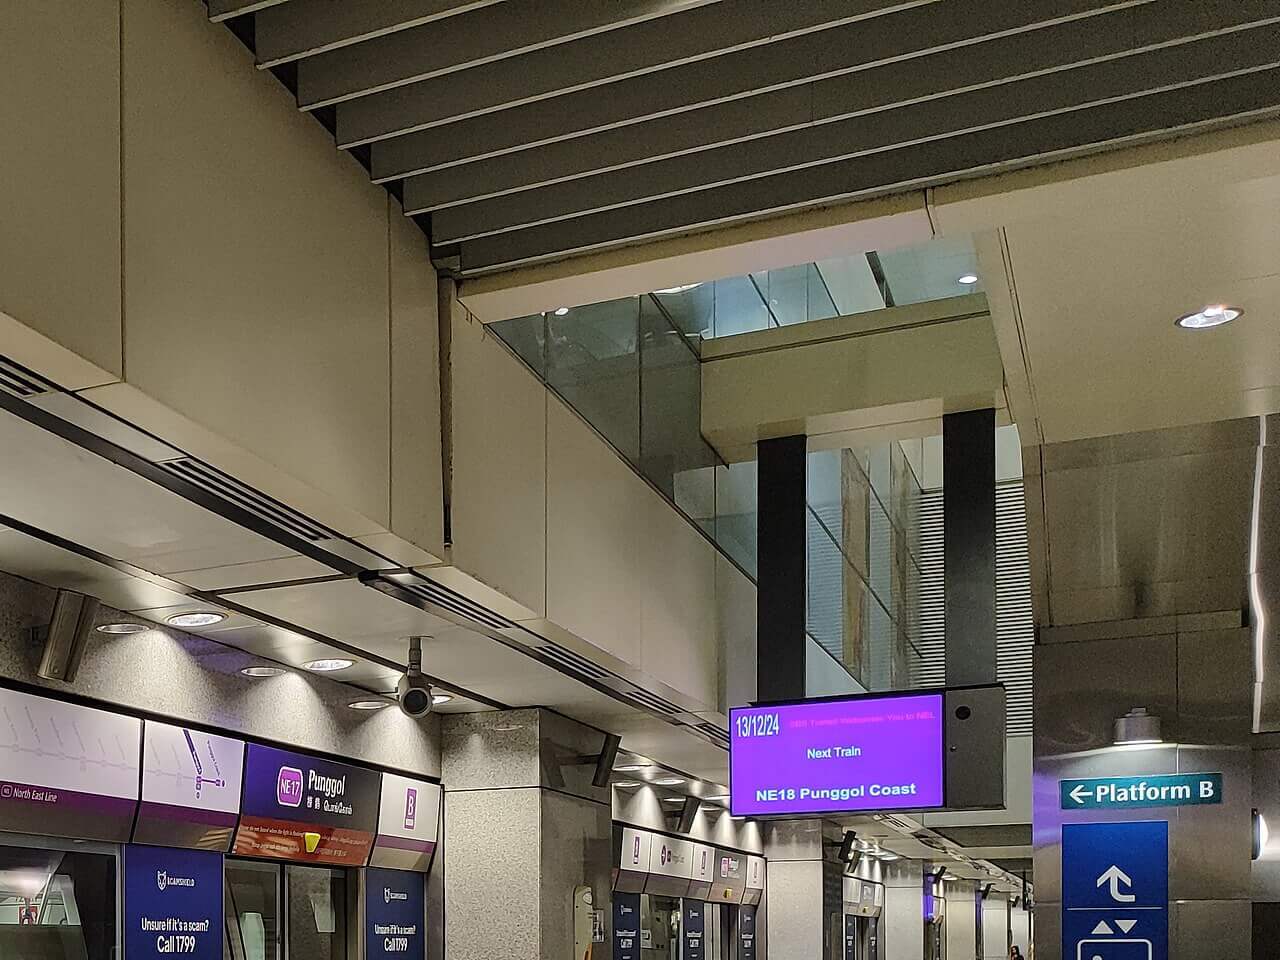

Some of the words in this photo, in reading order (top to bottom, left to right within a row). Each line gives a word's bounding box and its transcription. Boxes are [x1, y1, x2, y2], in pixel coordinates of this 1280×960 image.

[736, 713, 780, 738] 13/12/24
[807, 748, 831, 760] Next
[834, 746, 861, 758] Train
[308, 769, 346, 798] Punggol
[756, 788, 796, 802] NE18
[800, 784, 865, 801] Punggol
[869, 783, 916, 797] Coast
[1096, 781, 1190, 803] Platform
[1199, 781, 1214, 799] B
[13, 787, 31, 799] North
[31, 790, 45, 801] East
[45, 791, 58, 803] Line
[407, 795, 414, 816] B
[141, 917, 166, 931] Unsure
[188, 919, 210, 932] scam?
[157, 935, 175, 953] Call
[175, 935, 196, 953] 1799
